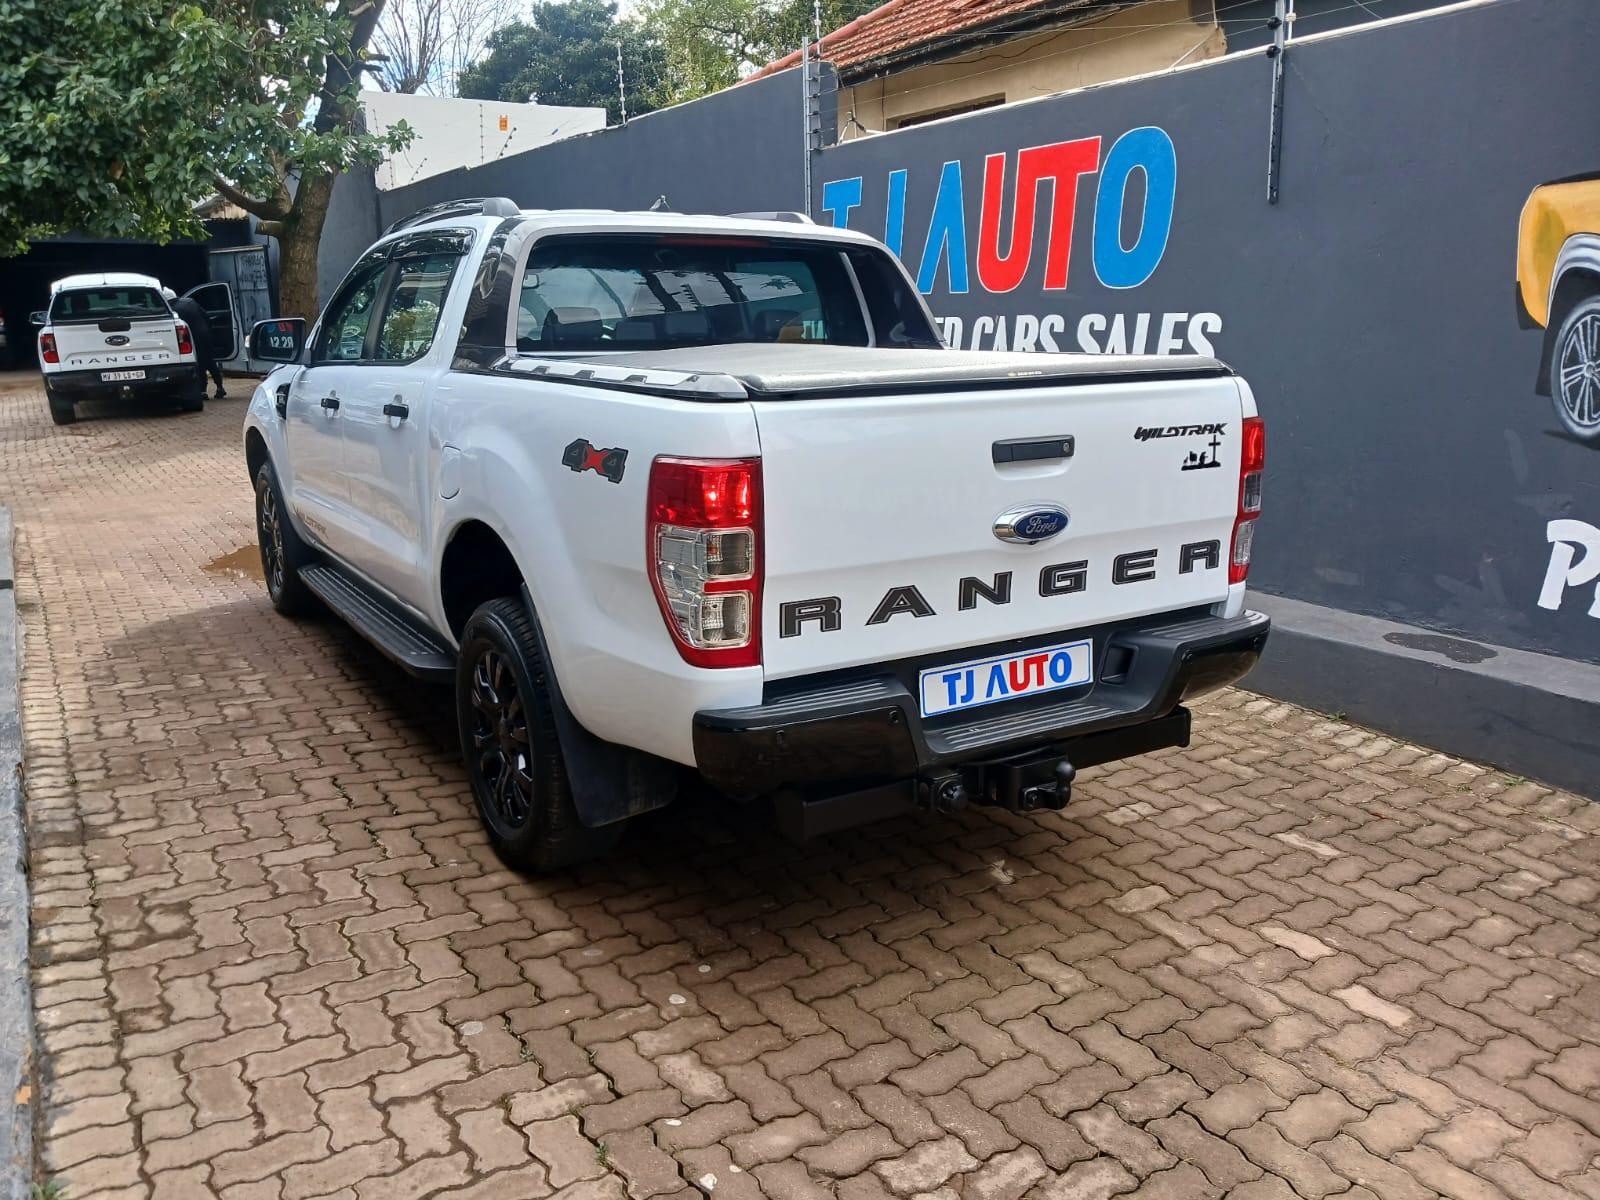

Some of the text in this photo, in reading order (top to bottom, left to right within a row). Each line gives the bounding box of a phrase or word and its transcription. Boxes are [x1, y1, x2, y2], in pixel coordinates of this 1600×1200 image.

[915, 126, 1177, 294] AUTO
[71, 353, 170, 365] RANGER
[970, 313, 1065, 352] CARS
[1133, 423, 1229, 442] WILDTRAK
[778, 539, 1221, 638] RANGER
[1537, 519, 1600, 619] P
[943, 651, 1073, 706] TJ AUTO
